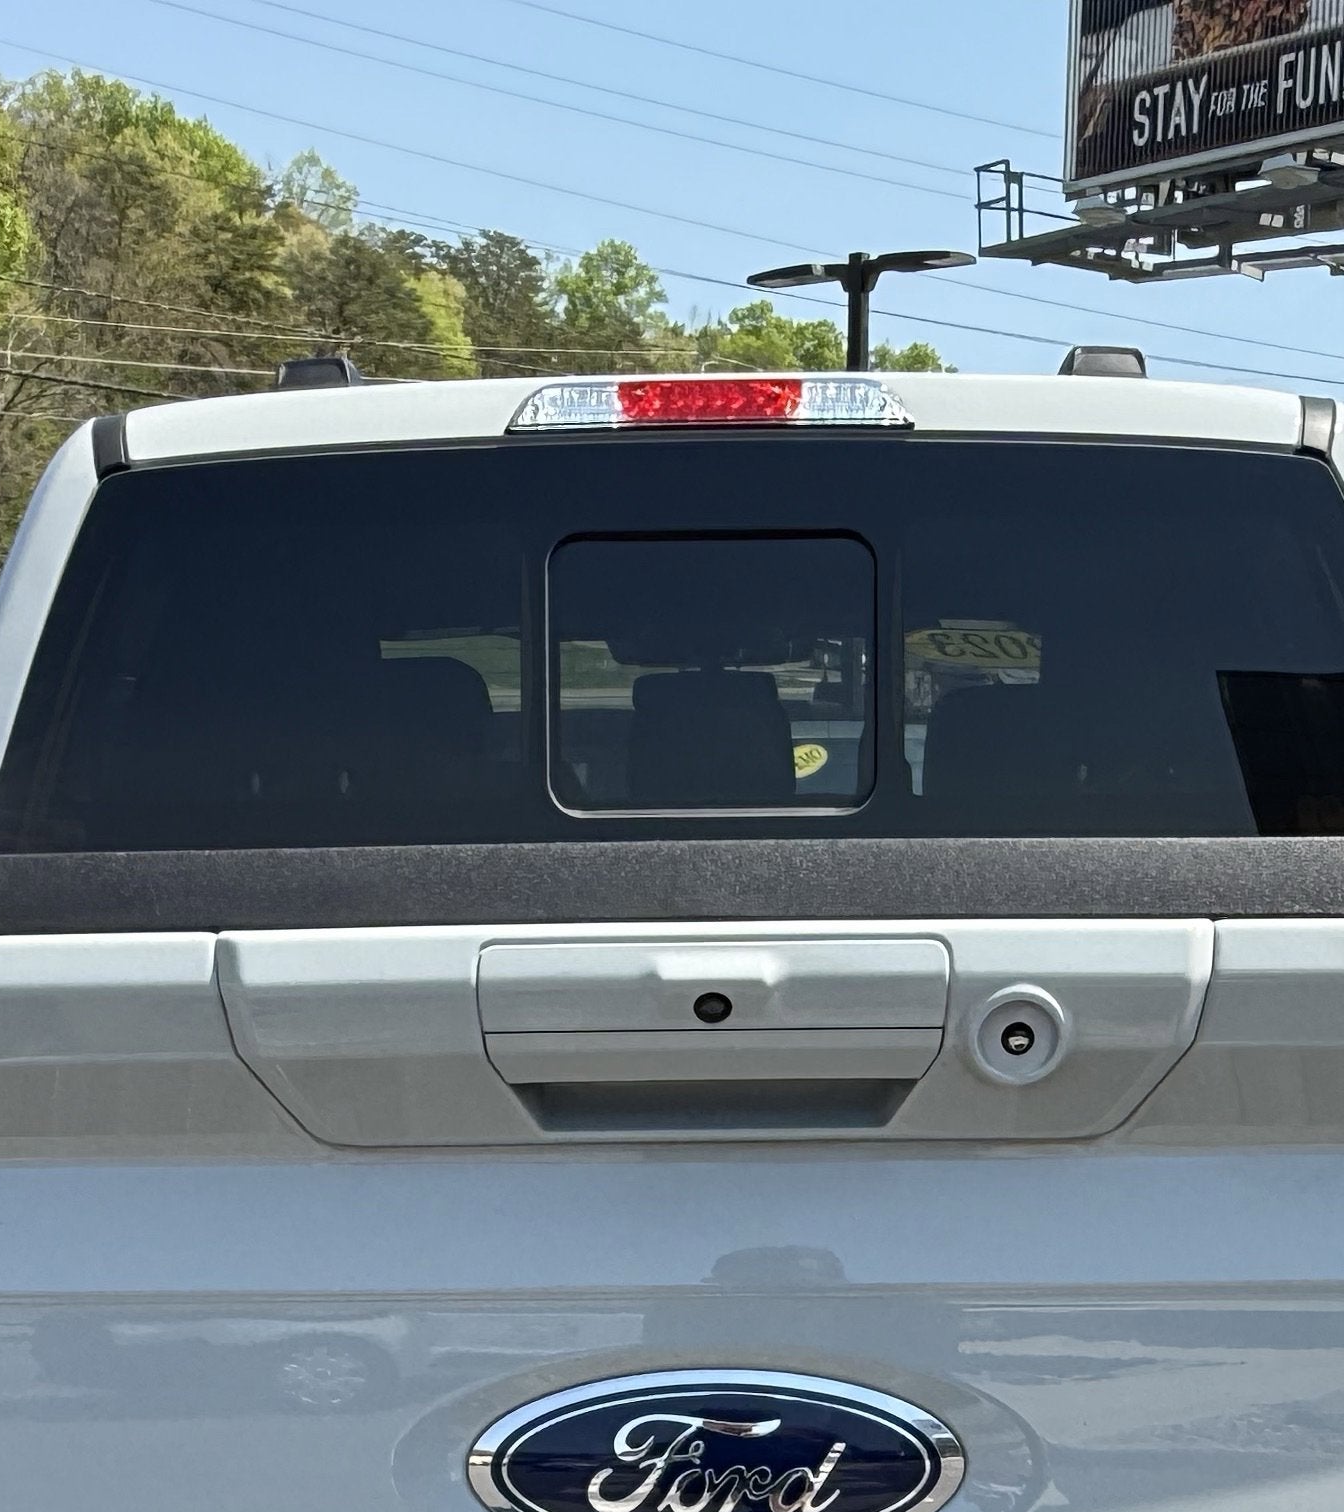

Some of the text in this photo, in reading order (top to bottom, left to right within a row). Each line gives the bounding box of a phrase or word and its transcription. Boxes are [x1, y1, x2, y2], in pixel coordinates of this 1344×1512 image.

[1133, 72, 1208, 147] STAY
[1208, 88, 1237, 119] FOR
[1240, 79, 1269, 111] THE
